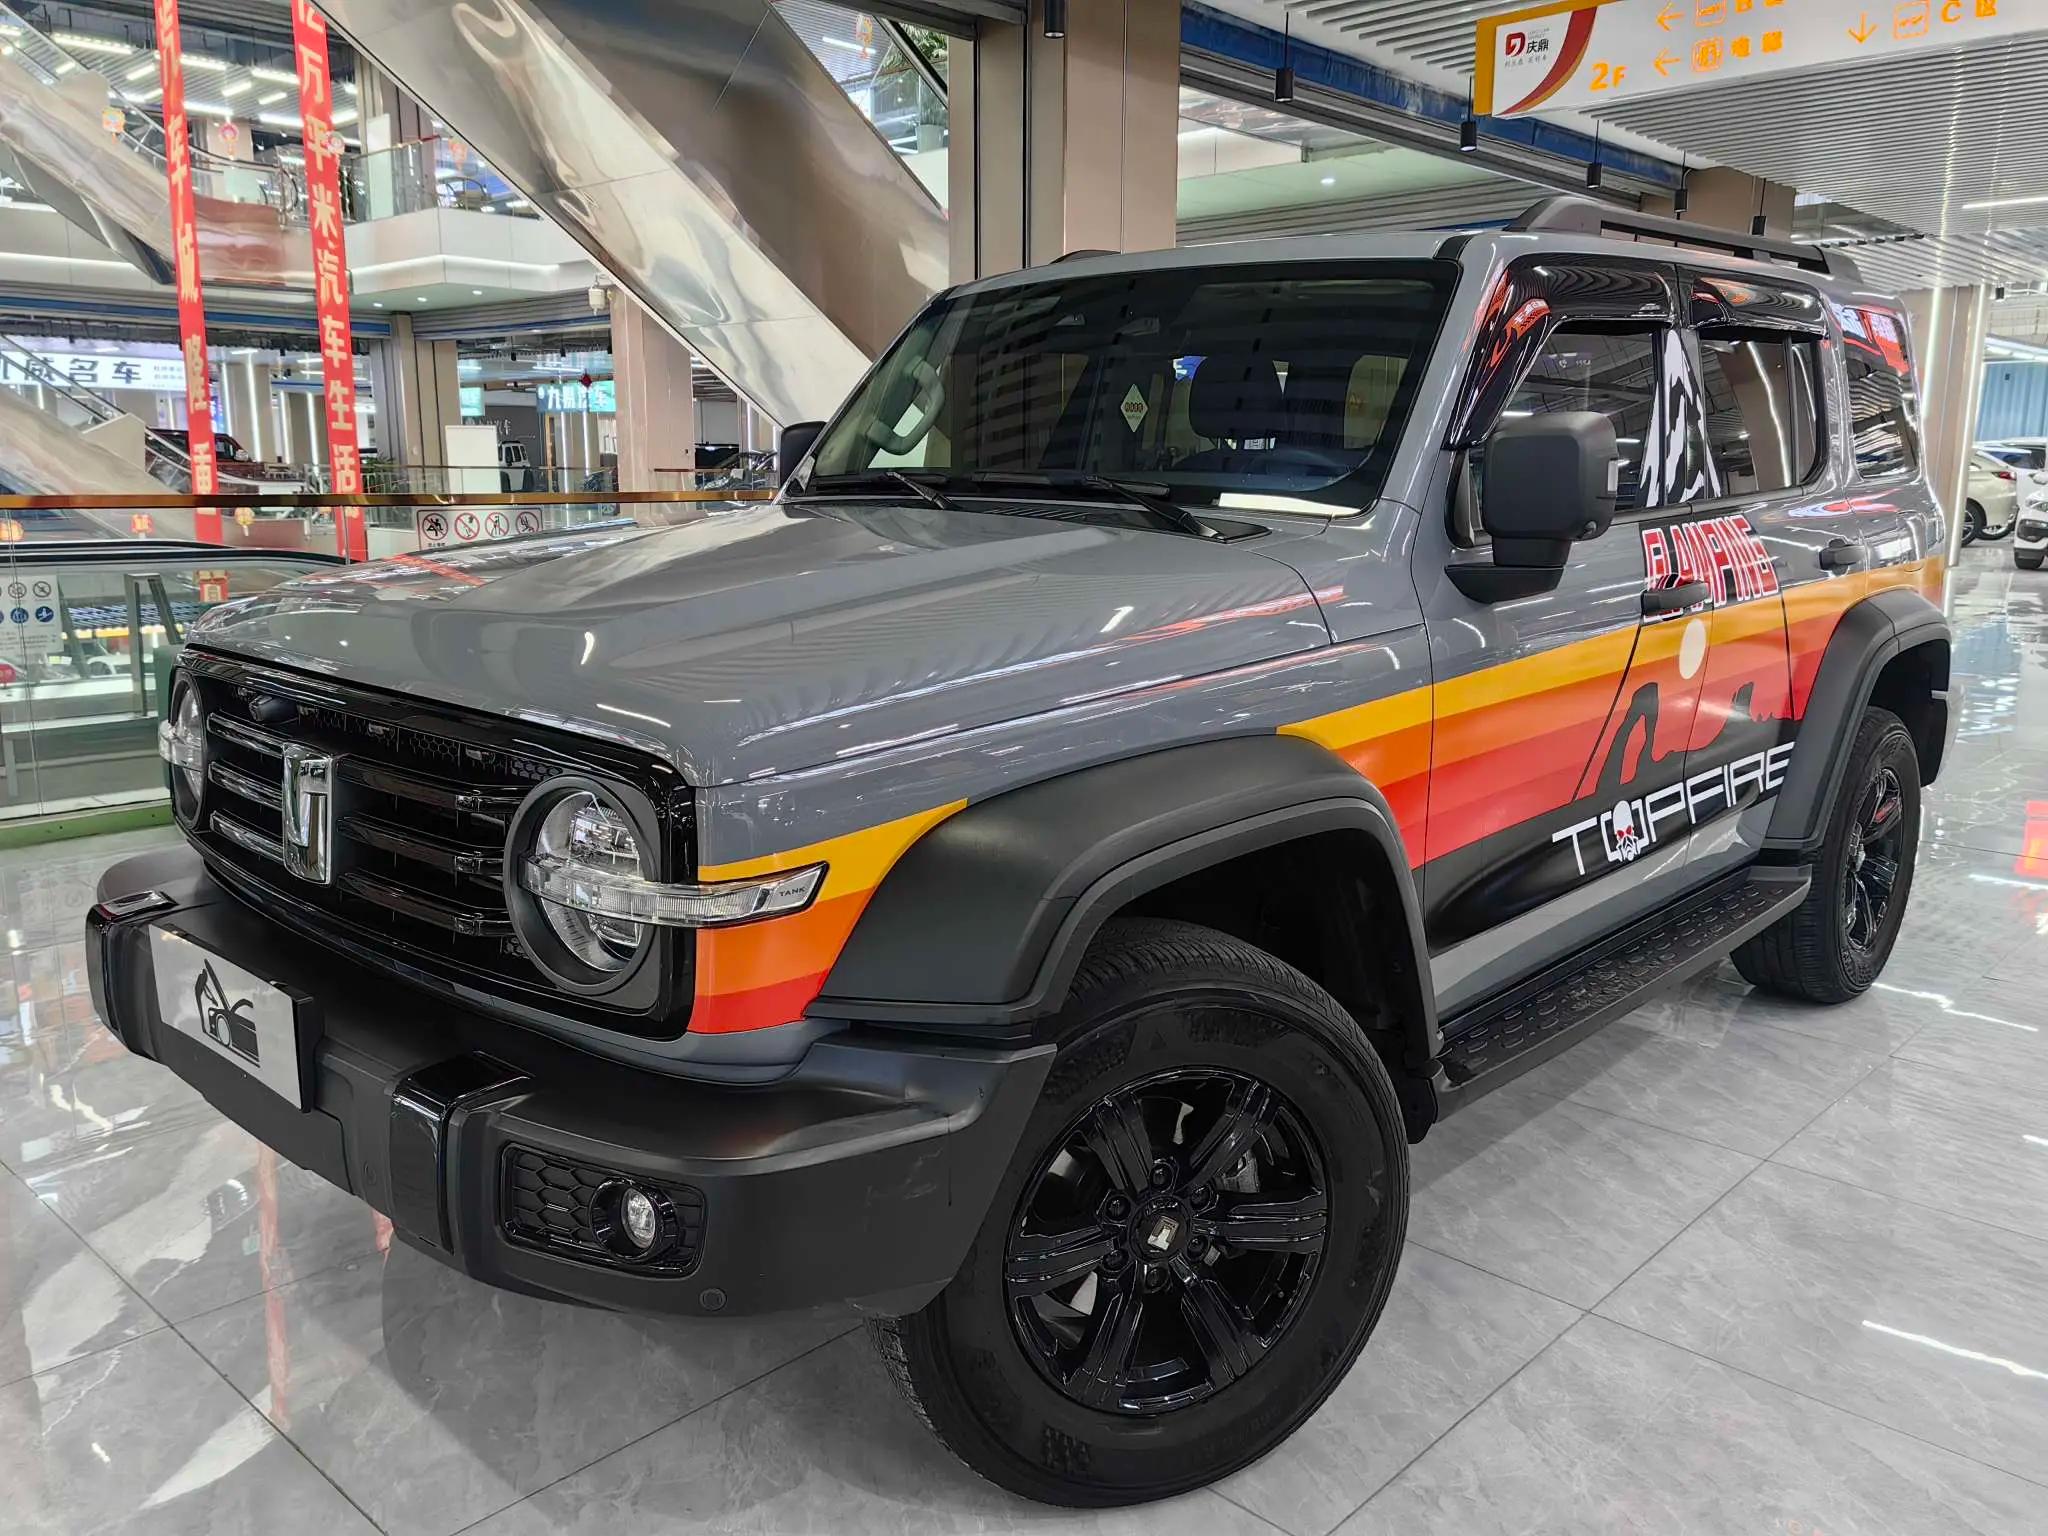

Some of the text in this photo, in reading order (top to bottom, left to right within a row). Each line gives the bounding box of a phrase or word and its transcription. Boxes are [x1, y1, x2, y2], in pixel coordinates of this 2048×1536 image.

[1526, 38, 1550, 54] 庆鼎
[1589, 62, 1628, 92] 2F
[779, 887, 806, 897] TANK
